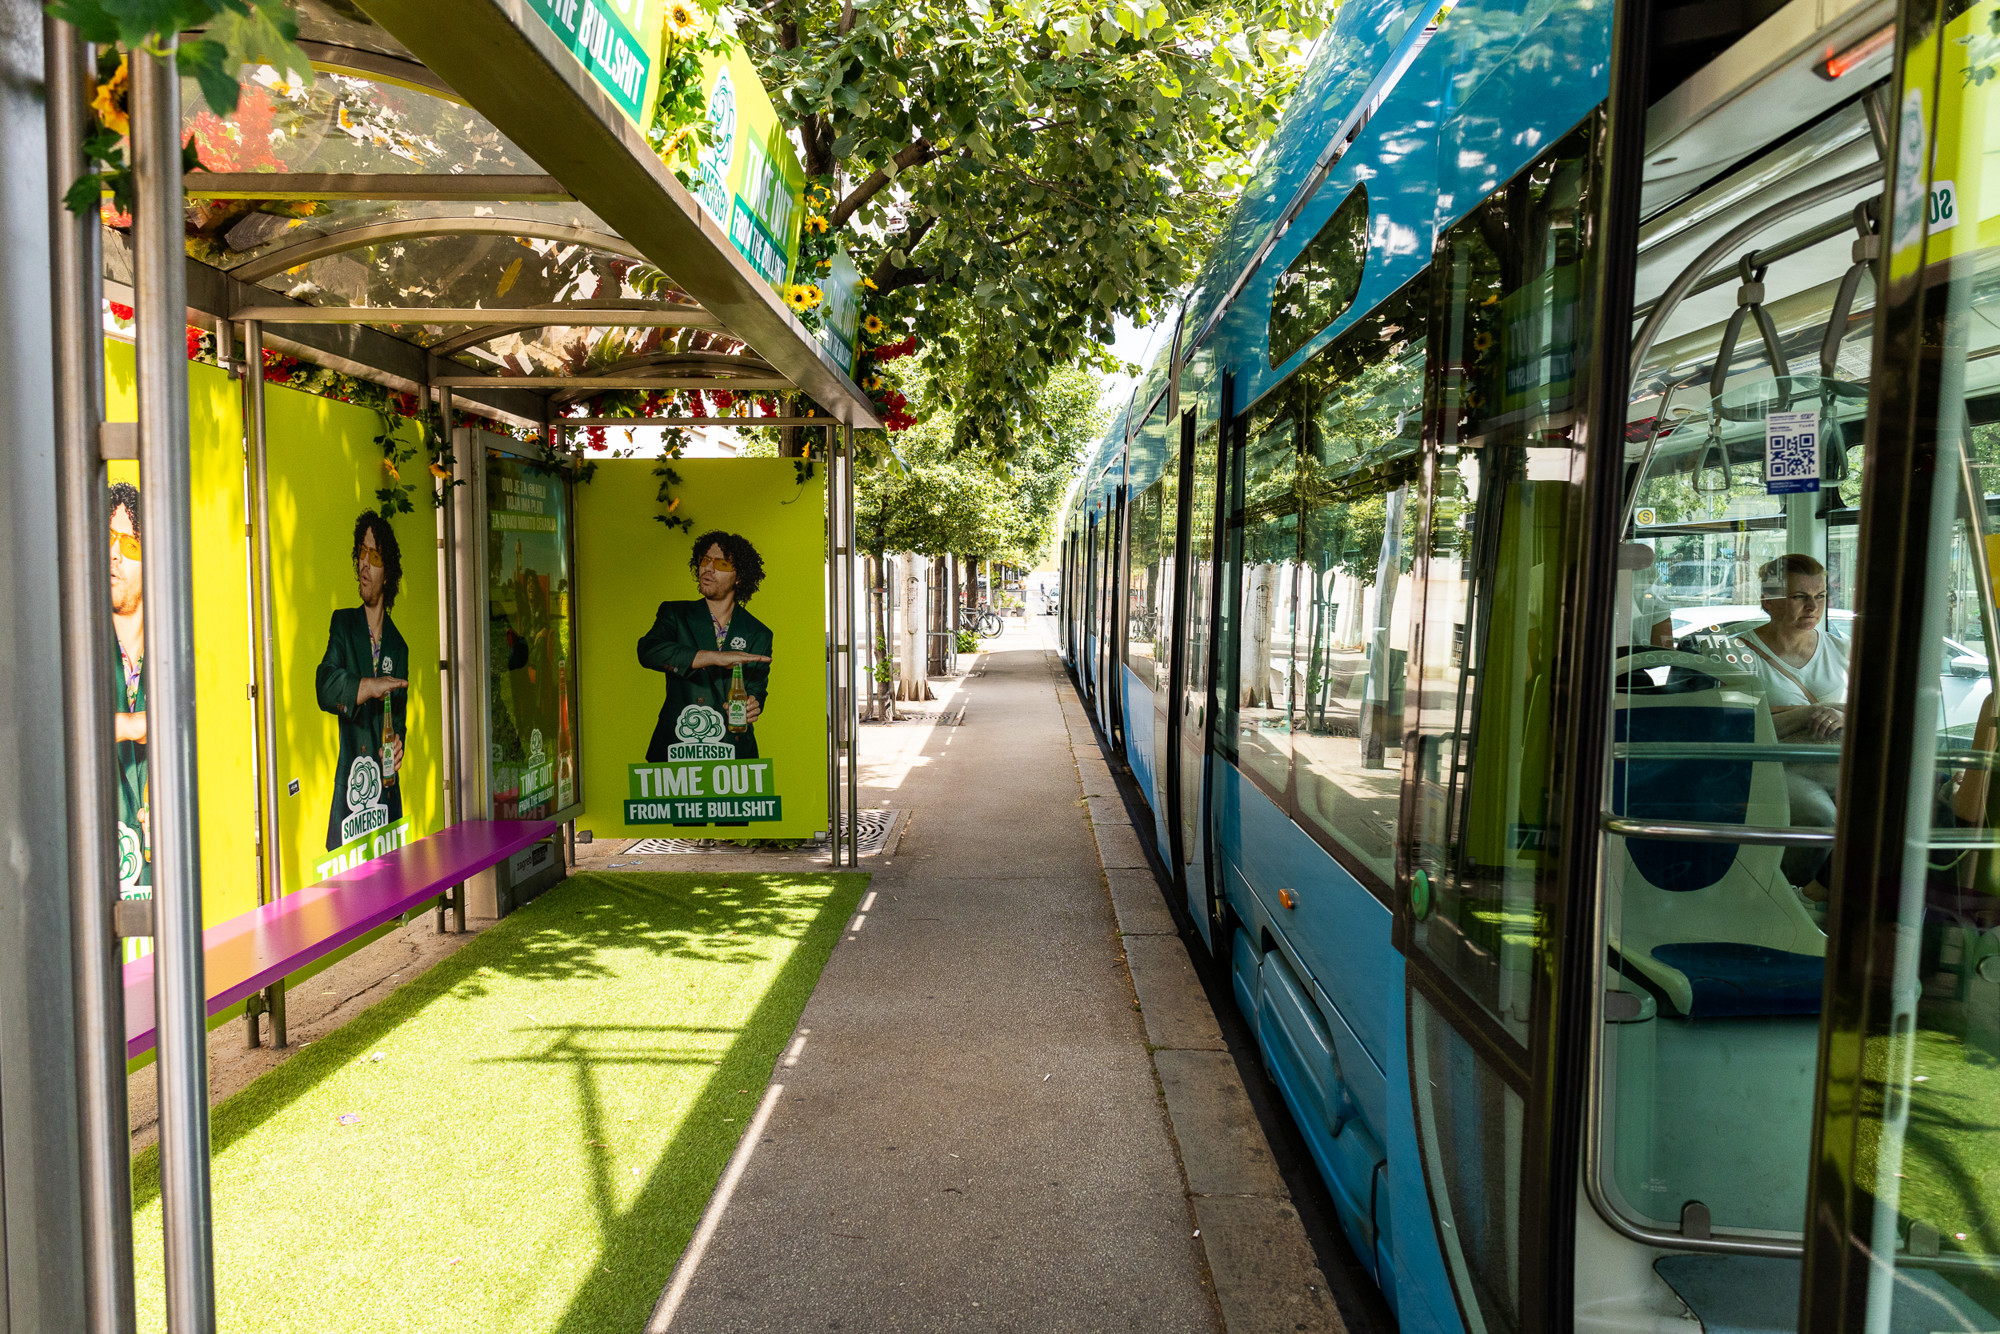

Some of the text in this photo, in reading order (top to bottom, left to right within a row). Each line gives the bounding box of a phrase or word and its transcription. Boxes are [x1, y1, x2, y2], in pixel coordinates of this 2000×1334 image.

[578, 0, 645, 105] BULLSHIT
[744, 137, 793, 246] TIME OUT
[732, 204, 786, 288] FROM THE BULLSHIT
[670, 745, 734, 759] SOMERSBY
[520, 769, 538, 797] TIME
[540, 762, 553, 787] OUT
[634, 764, 768, 797] TIME OUT
[344, 808, 387, 839] SOMERSBY
[629, 800, 776, 820] FROM THE BULLSHIT
